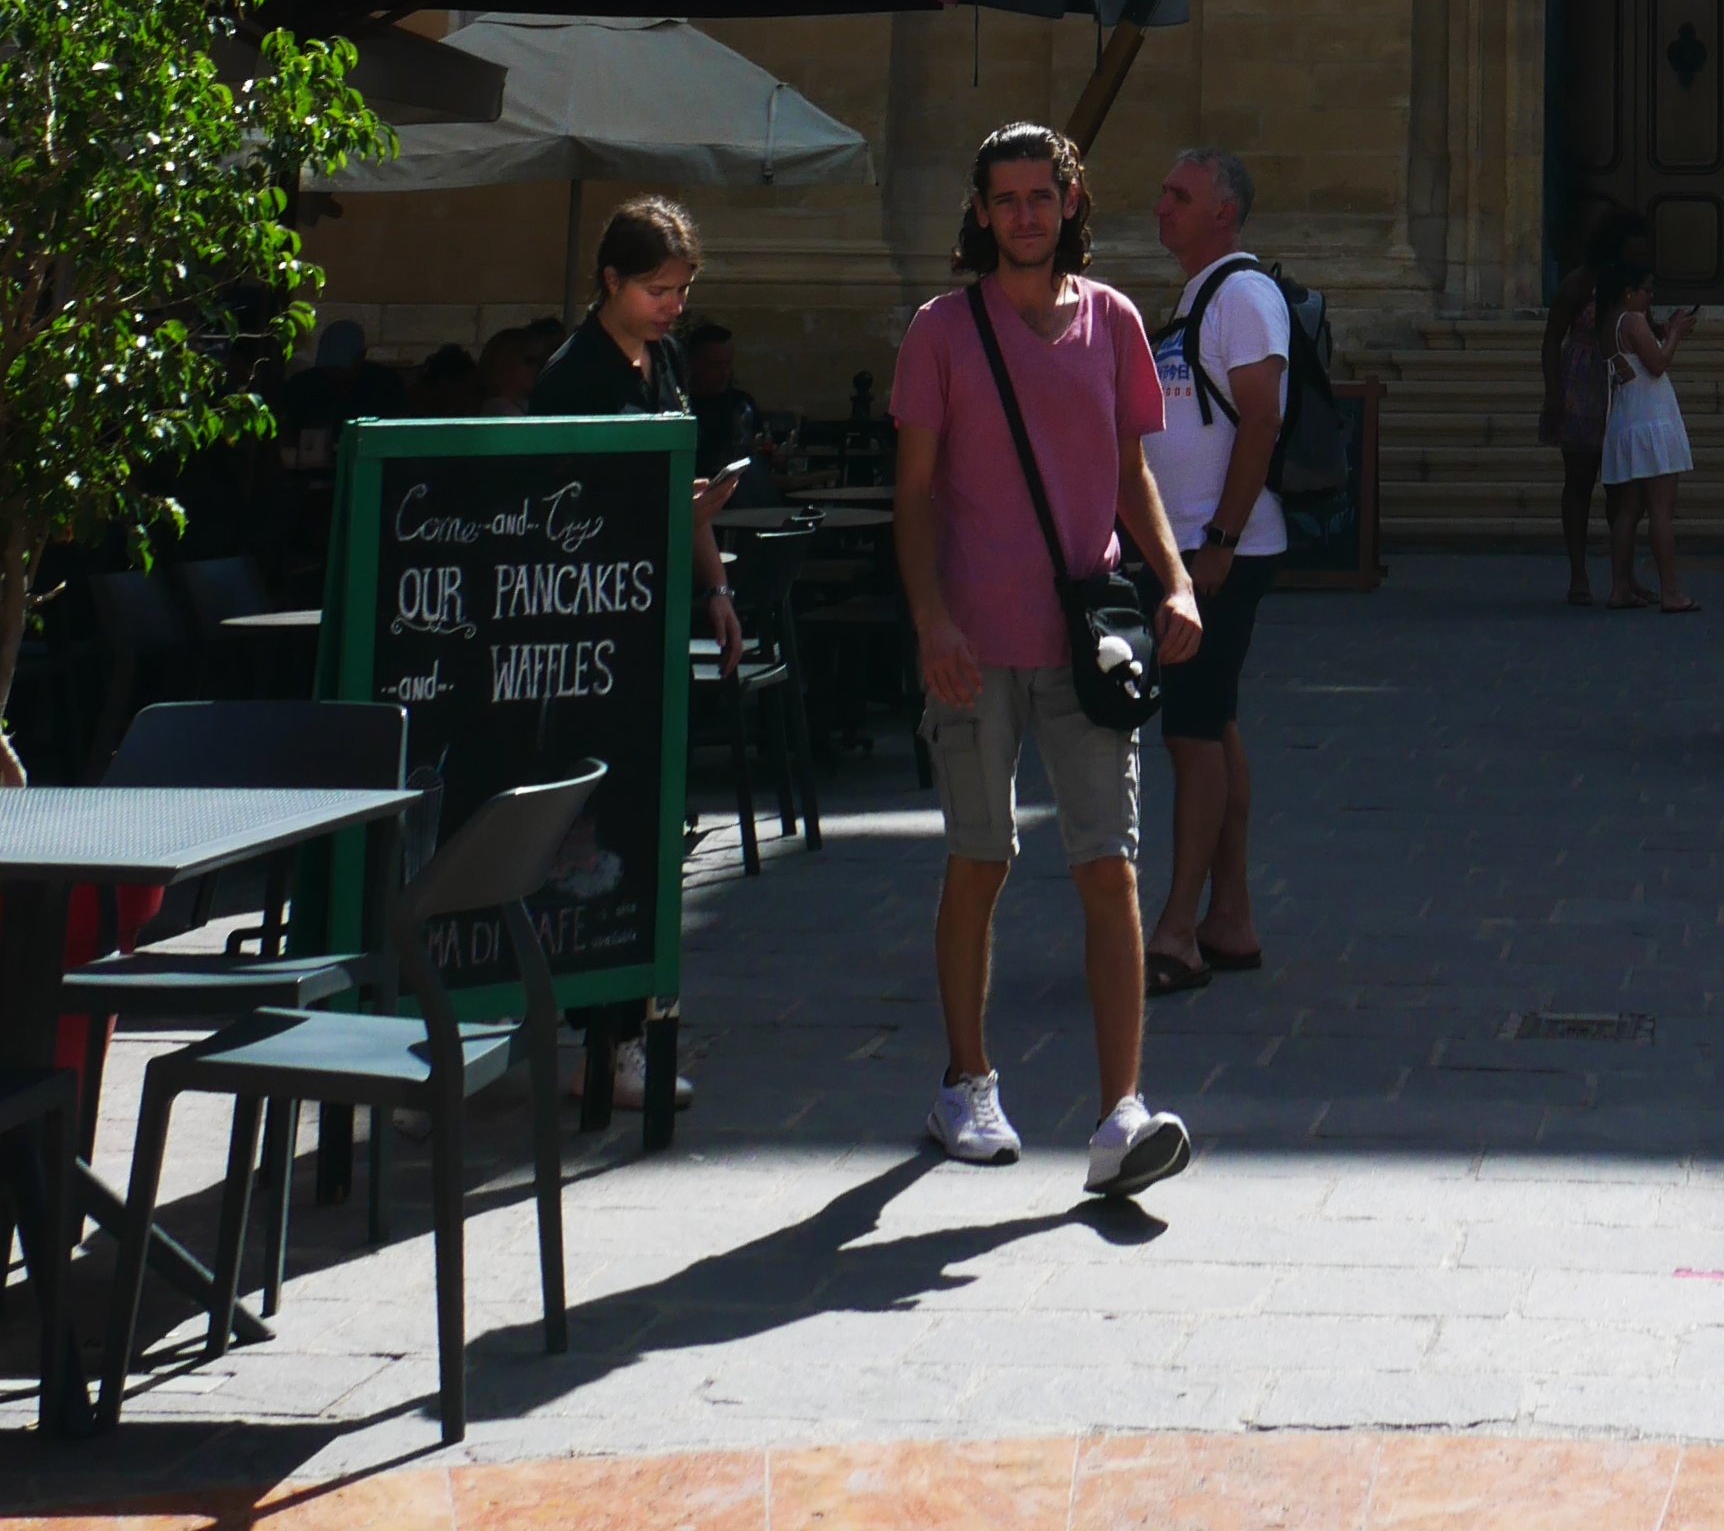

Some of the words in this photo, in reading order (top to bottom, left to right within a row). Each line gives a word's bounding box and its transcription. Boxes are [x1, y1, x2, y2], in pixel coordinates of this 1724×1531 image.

[396, 483, 479, 543] Come
[398, 566, 464, 623] OUR
[493, 560, 653, 619] PANCAKES
[491, 640, 615, 702] WAFFLES
[471, 920, 500, 965] DI
[535, 905, 588, 957] AFE
